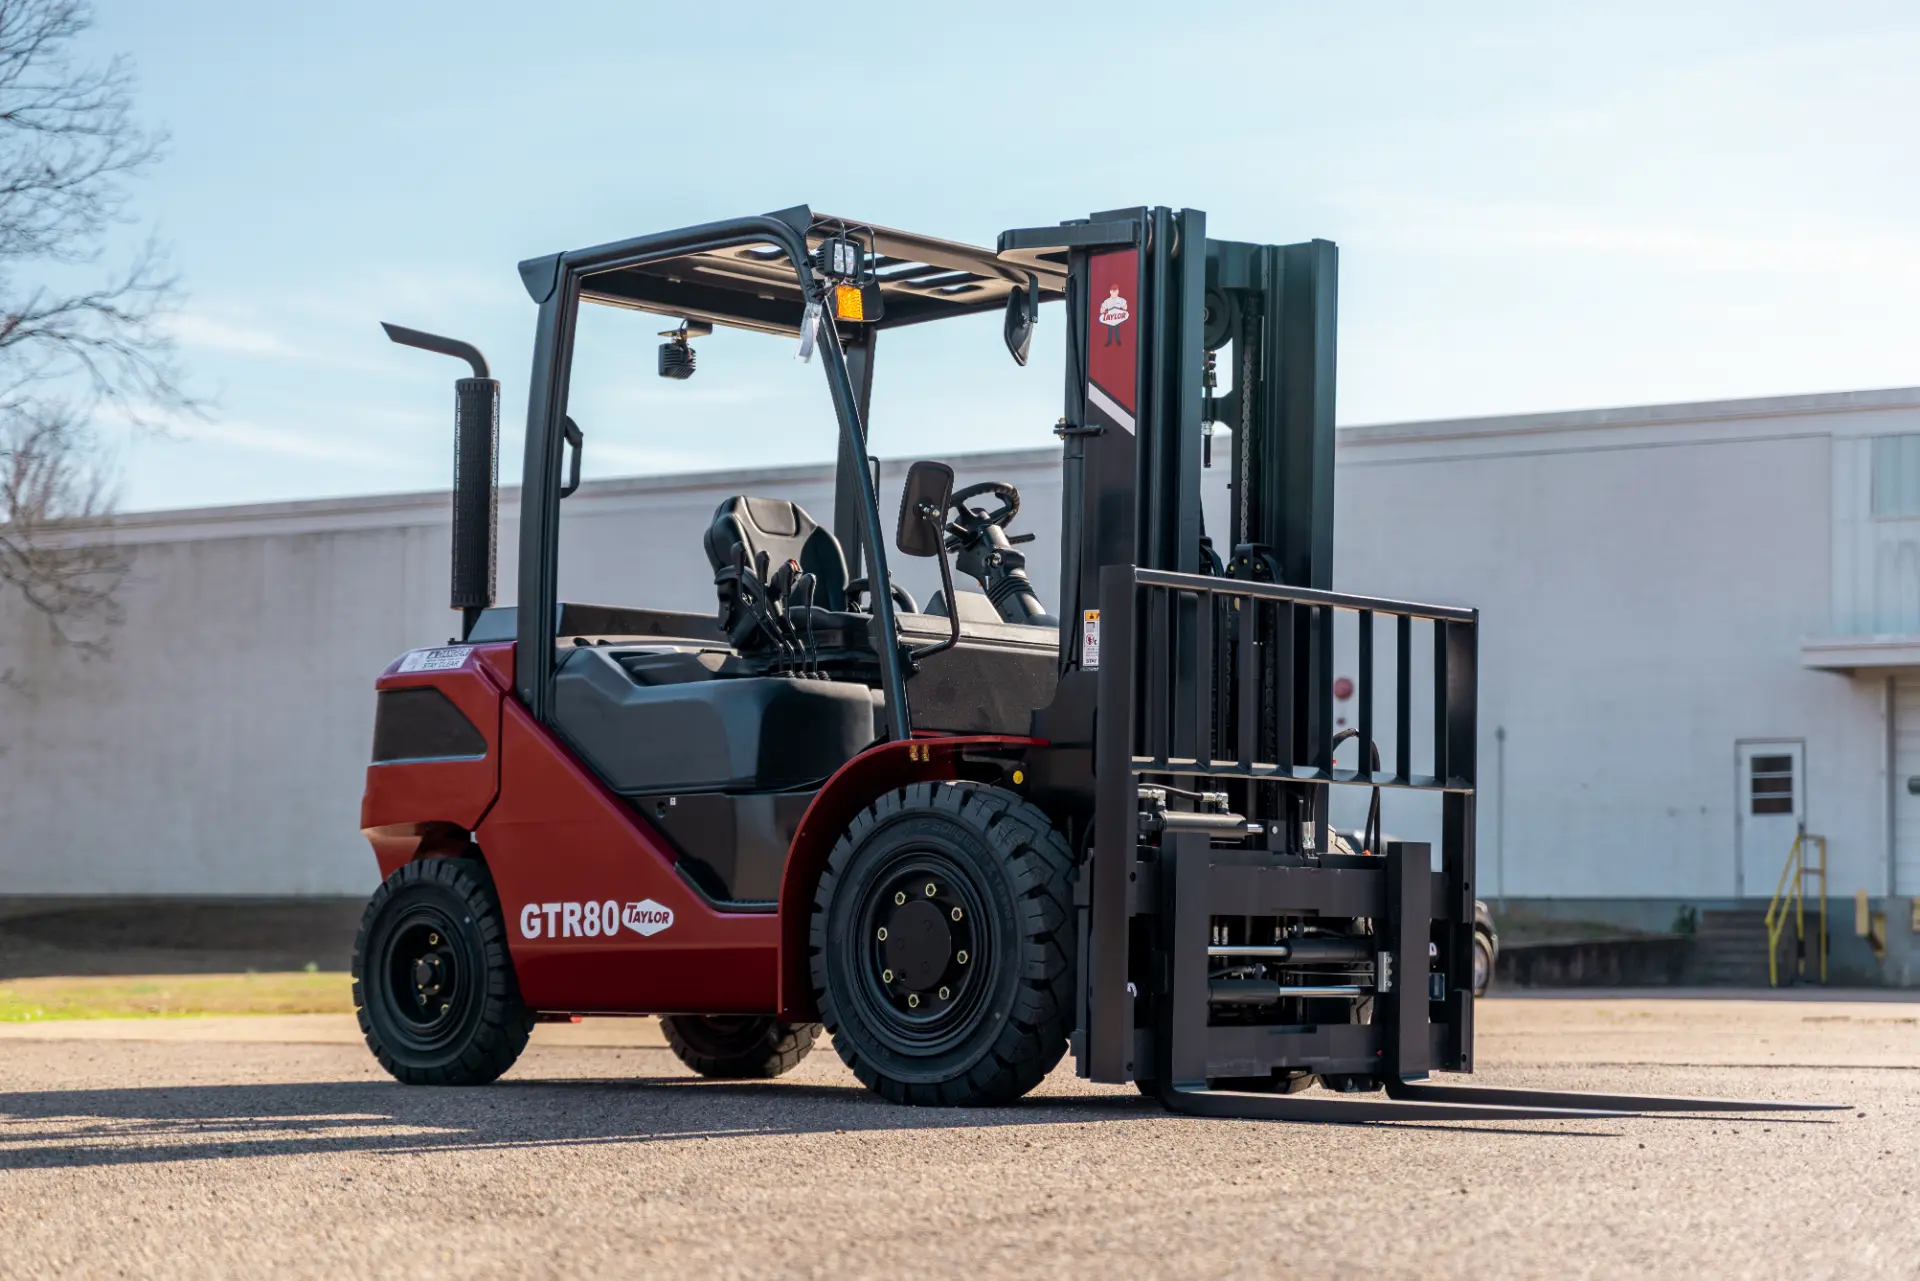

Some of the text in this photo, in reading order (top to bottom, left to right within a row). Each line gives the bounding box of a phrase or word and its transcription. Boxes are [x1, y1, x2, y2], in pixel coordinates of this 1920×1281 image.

[1102, 309, 1126, 321] TAYLOR
[438, 660, 460, 668] CLEAR
[520, 900, 670, 939] GTR80 TAYLOR
